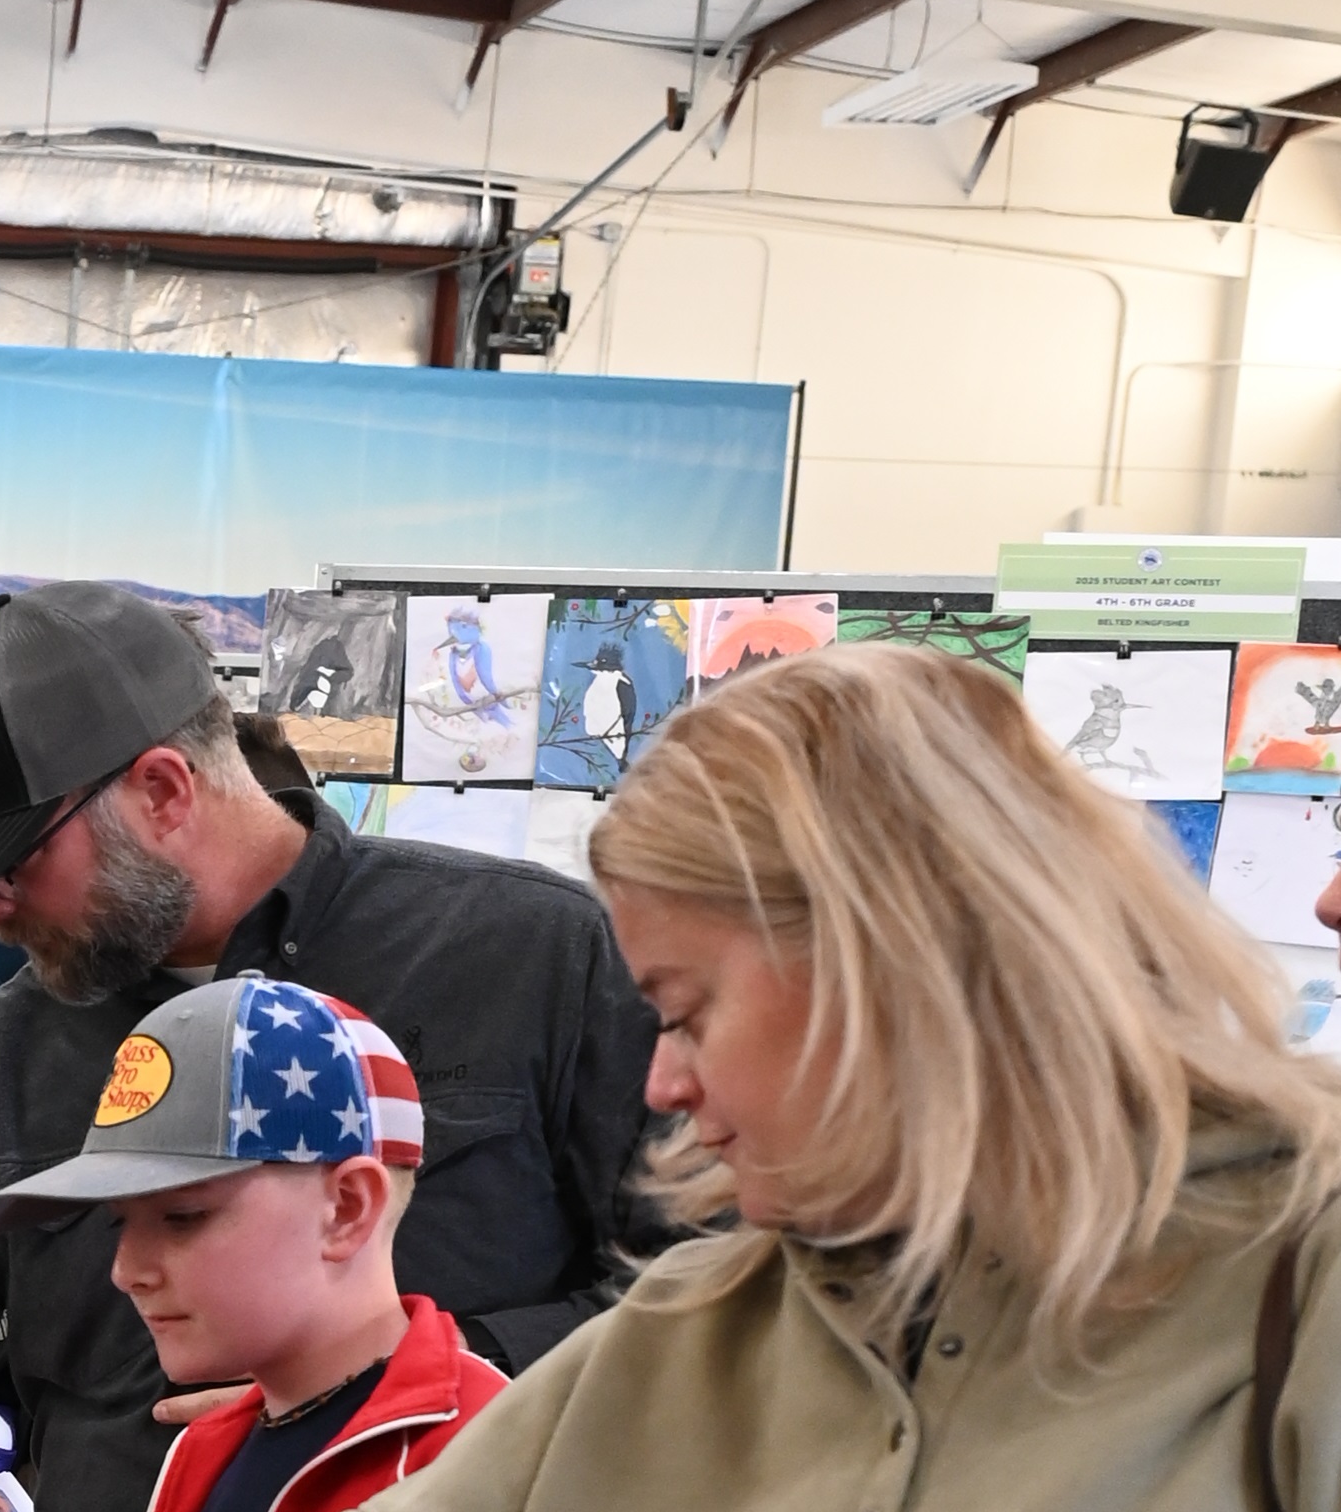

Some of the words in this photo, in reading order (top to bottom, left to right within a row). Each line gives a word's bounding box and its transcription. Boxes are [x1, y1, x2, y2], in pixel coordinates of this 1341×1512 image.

[1076, 577, 1100, 585] 2025
[1102, 577, 1148, 586] STUDENT
[1151, 578, 1172, 586] ART
[1174, 578, 1221, 587] CONTEST
[1096, 597, 1119, 606] 4TH
[1155, 599, 1196, 607] GRADE
[1097, 618, 1132, 626] BELTED
[1135, 619, 1190, 627] KINGFISHER
[117, 1040, 159, 1064] Bass
[111, 1064, 138, 1085] Pro
[103, 1085, 155, 1113] Shops
